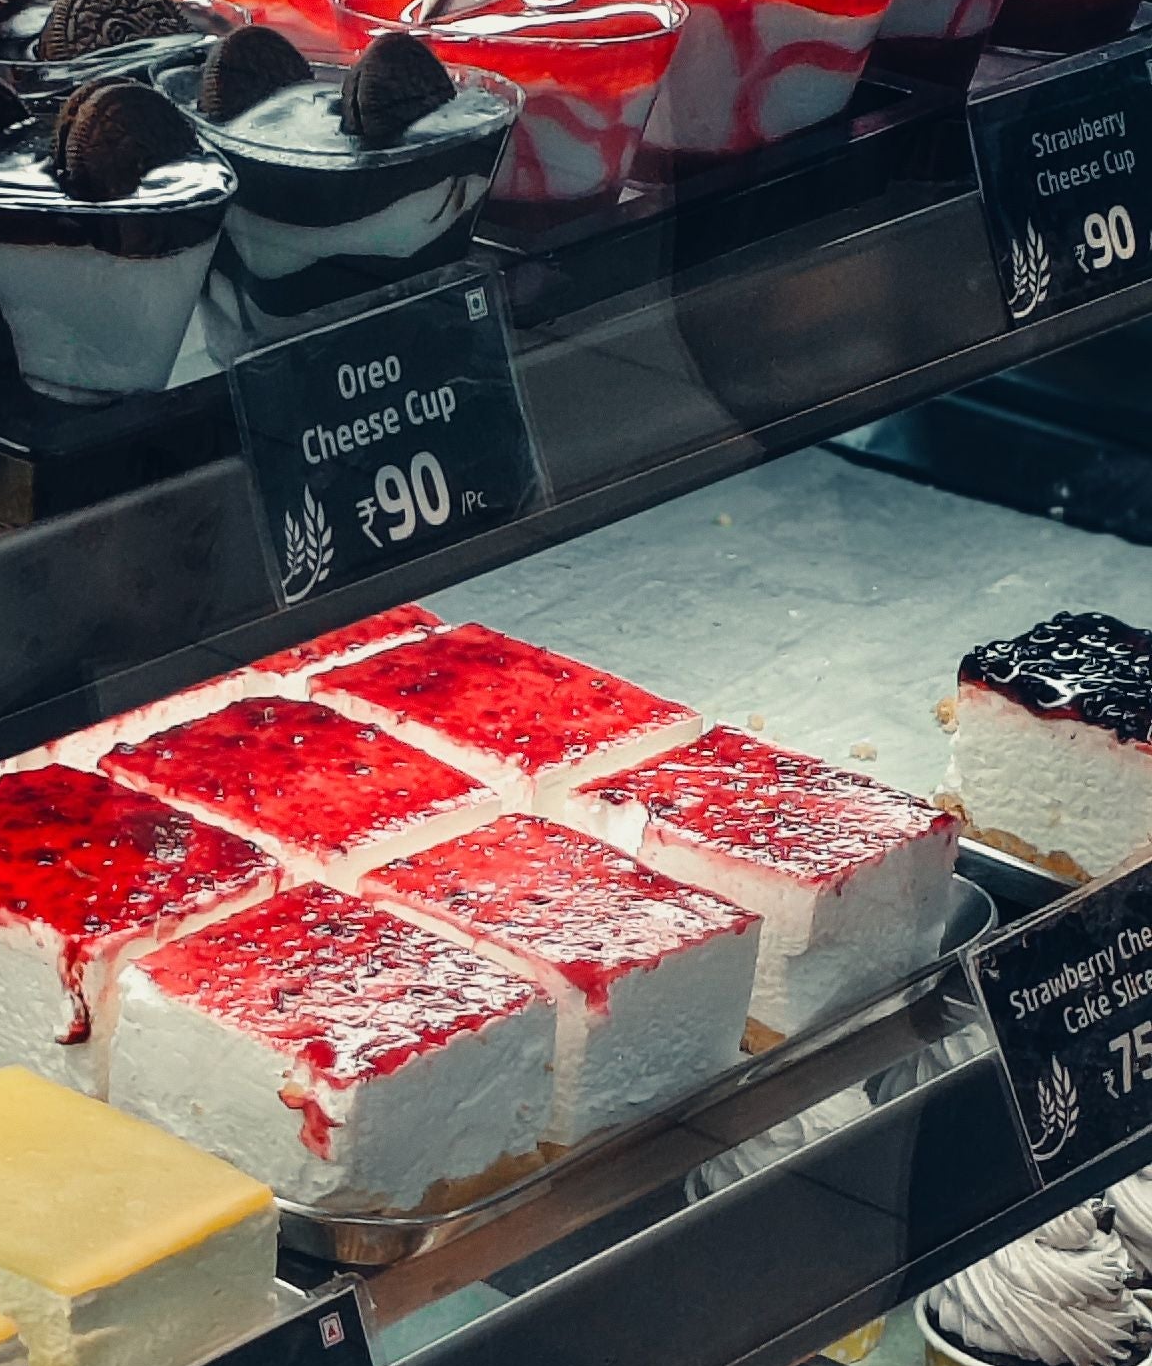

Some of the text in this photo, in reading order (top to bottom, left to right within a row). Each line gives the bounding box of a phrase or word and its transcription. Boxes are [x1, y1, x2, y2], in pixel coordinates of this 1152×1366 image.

[1032, 111, 1126, 157] Strawberry
[1036, 149, 1135, 196] Cheese Cup
[338, 355, 401, 400] Oreo
[302, 386, 457, 464] Cheese Cup
[1010, 945, 1115, 1020] Strawberry
[1064, 993, 1112, 1034] Cake
